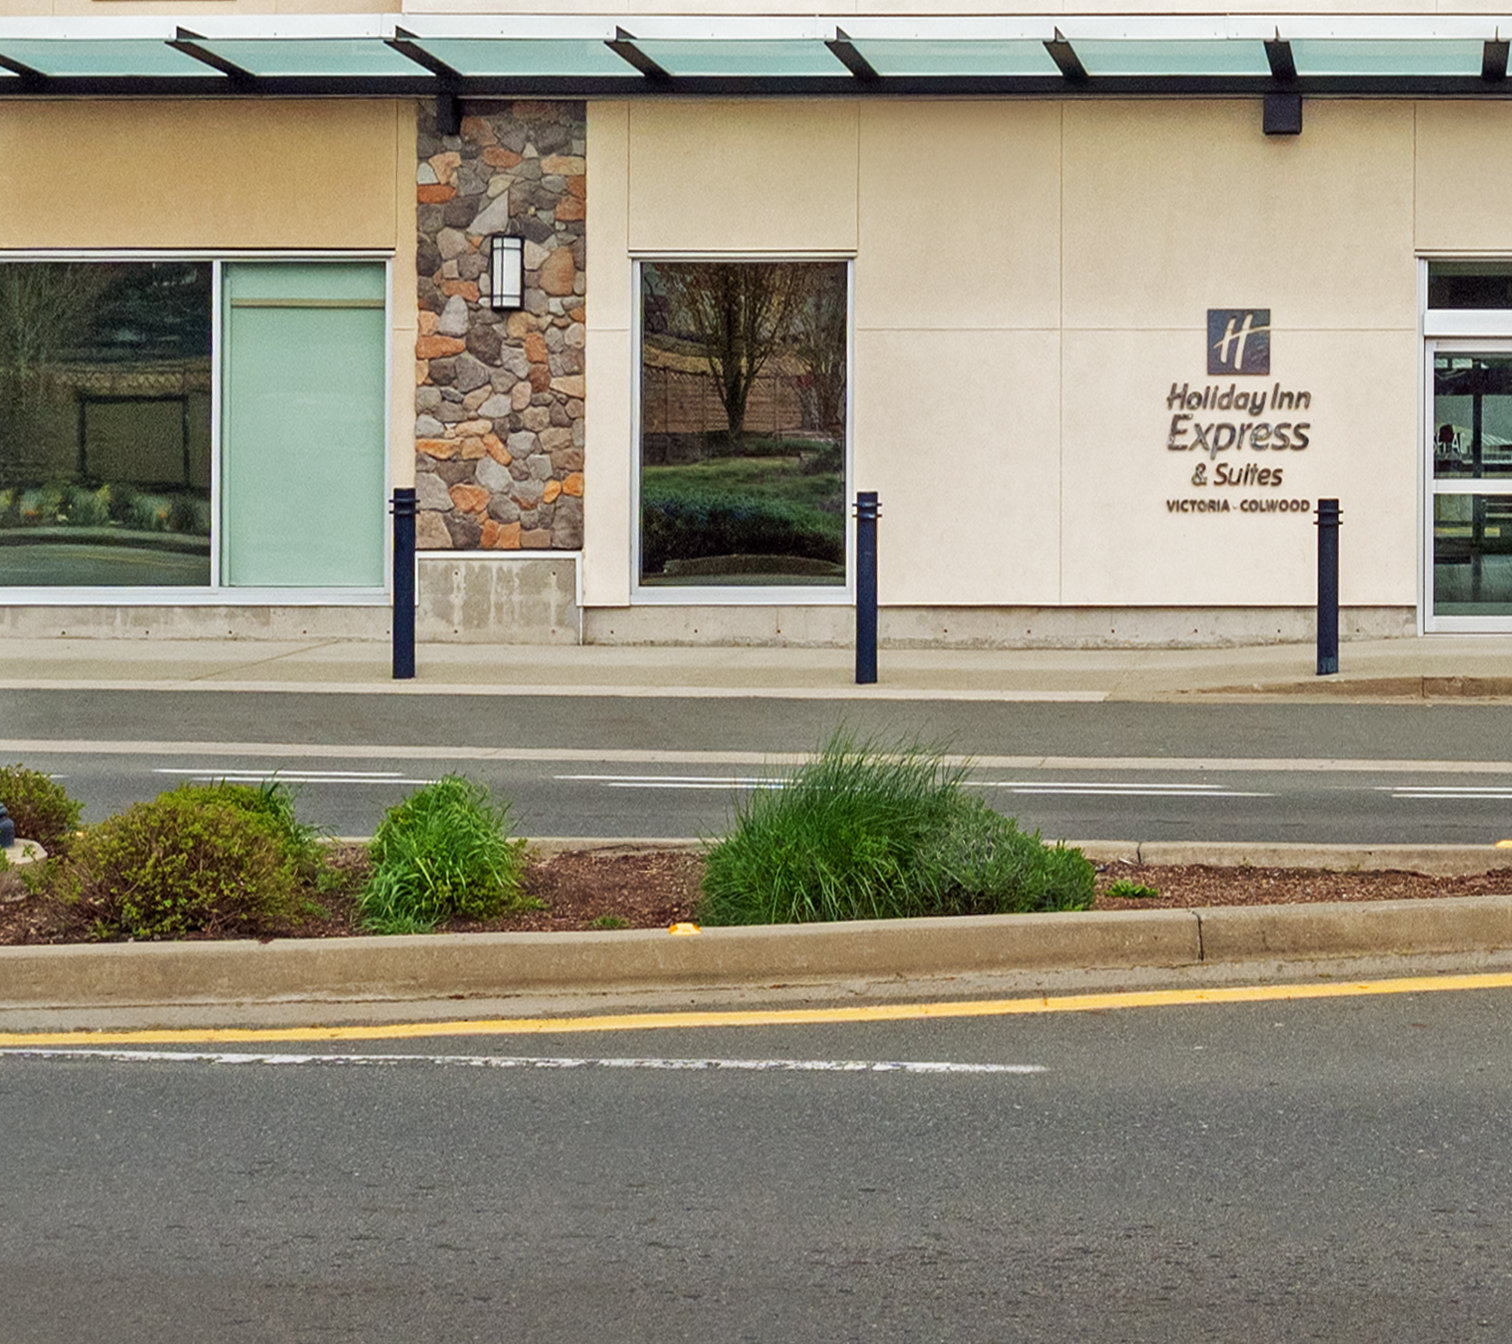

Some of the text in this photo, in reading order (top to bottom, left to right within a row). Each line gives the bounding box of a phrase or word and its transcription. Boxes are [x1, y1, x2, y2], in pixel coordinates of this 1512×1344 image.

[1166, 382, 1312, 416] Holiday Inn
[1167, 413, 1311, 461] Express
[1191, 462, 1284, 487] & Suites
[1166, 499, 1231, 513] VICTORIA
[1239, 499, 1311, 513] COLWOOD
